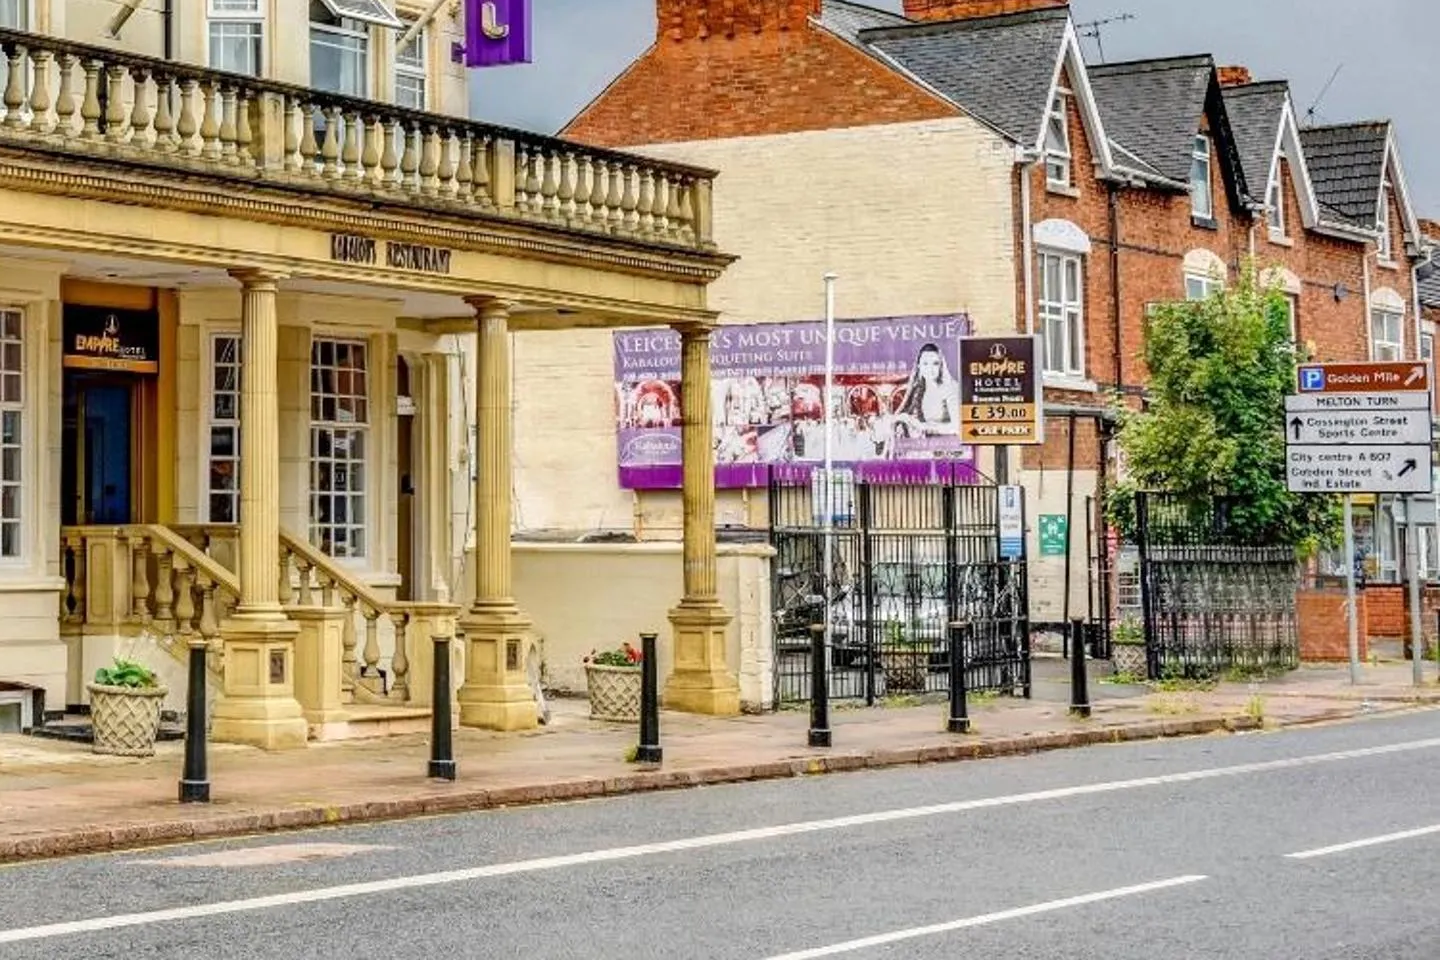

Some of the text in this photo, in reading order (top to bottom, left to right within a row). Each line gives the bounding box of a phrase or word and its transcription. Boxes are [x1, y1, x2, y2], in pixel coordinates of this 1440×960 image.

[385, 241, 451, 274] RESTAURANT
[738, 329, 794, 348] MOST
[800, 325, 881, 346] UNIQUE
[886, 321, 955, 340] VENUE
[75, 331, 120, 354] EMPIRE
[970, 358, 1026, 376] EMPIRE
[974, 377, 1021, 388] HOTEL
[1327, 371, 1370, 384] Golden
[1374, 371, 1401, 382] Mile
[1316, 396, 1399, 407] MELTON TURN
[1373, 415, 1409, 426] Street
[1318, 427, 1398, 440] Sports Centre
[1291, 452, 1312, 463] City
[1318, 452, 1353, 461] centre
[1338, 467, 1372, 477] Street
